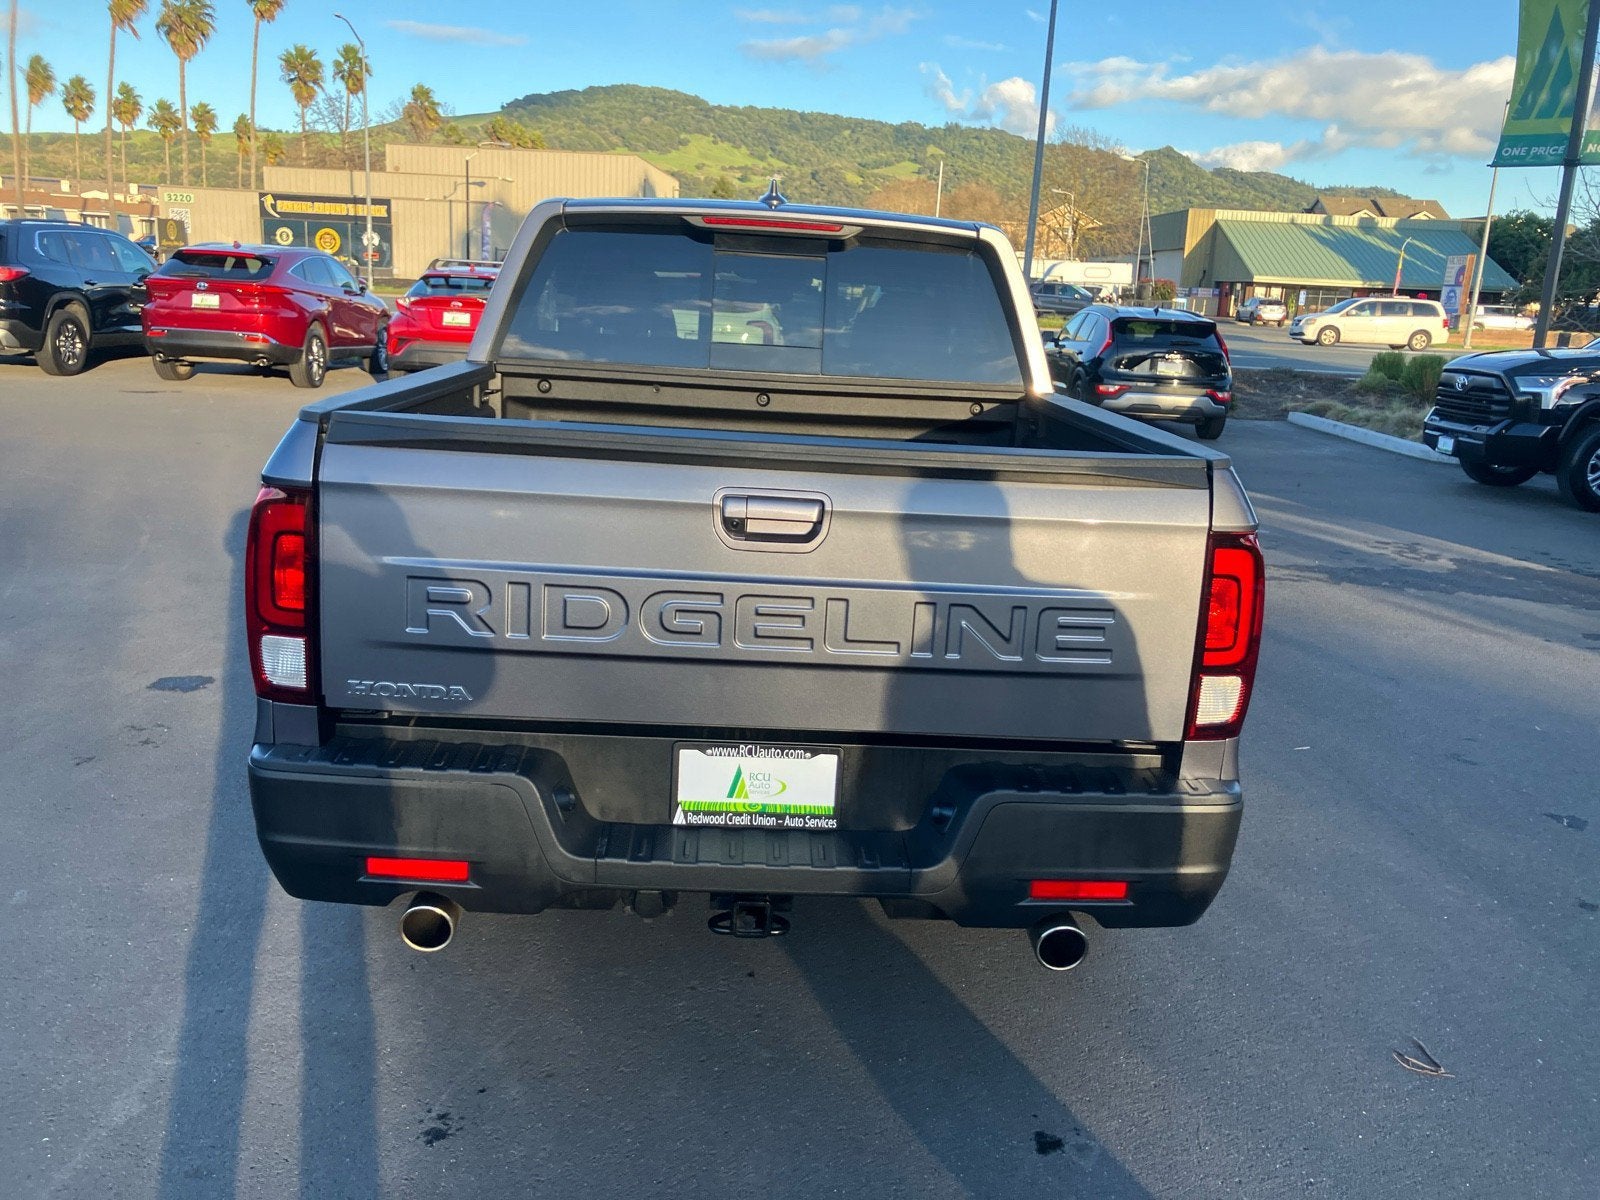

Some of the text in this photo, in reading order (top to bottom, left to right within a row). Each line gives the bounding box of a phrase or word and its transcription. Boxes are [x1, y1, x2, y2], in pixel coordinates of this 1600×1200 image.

[1502, 145, 1566, 157] ONE PRICE
[166, 193, 192, 203] 3220
[405, 575, 1116, 665] RIDGELINE
[347, 679, 473, 701] HONDA
[711, 745, 805, 760] www.RCUauto.com
[749, 772, 771, 782] RCU
[748, 781, 771, 790] Auto
[687, 812, 726, 825] Redwood
[726, 813, 751, 826] Credit
[752, 814, 777, 827] Union
[783, 816, 804, 828] Auto
[804, 816, 837, 829] Services
